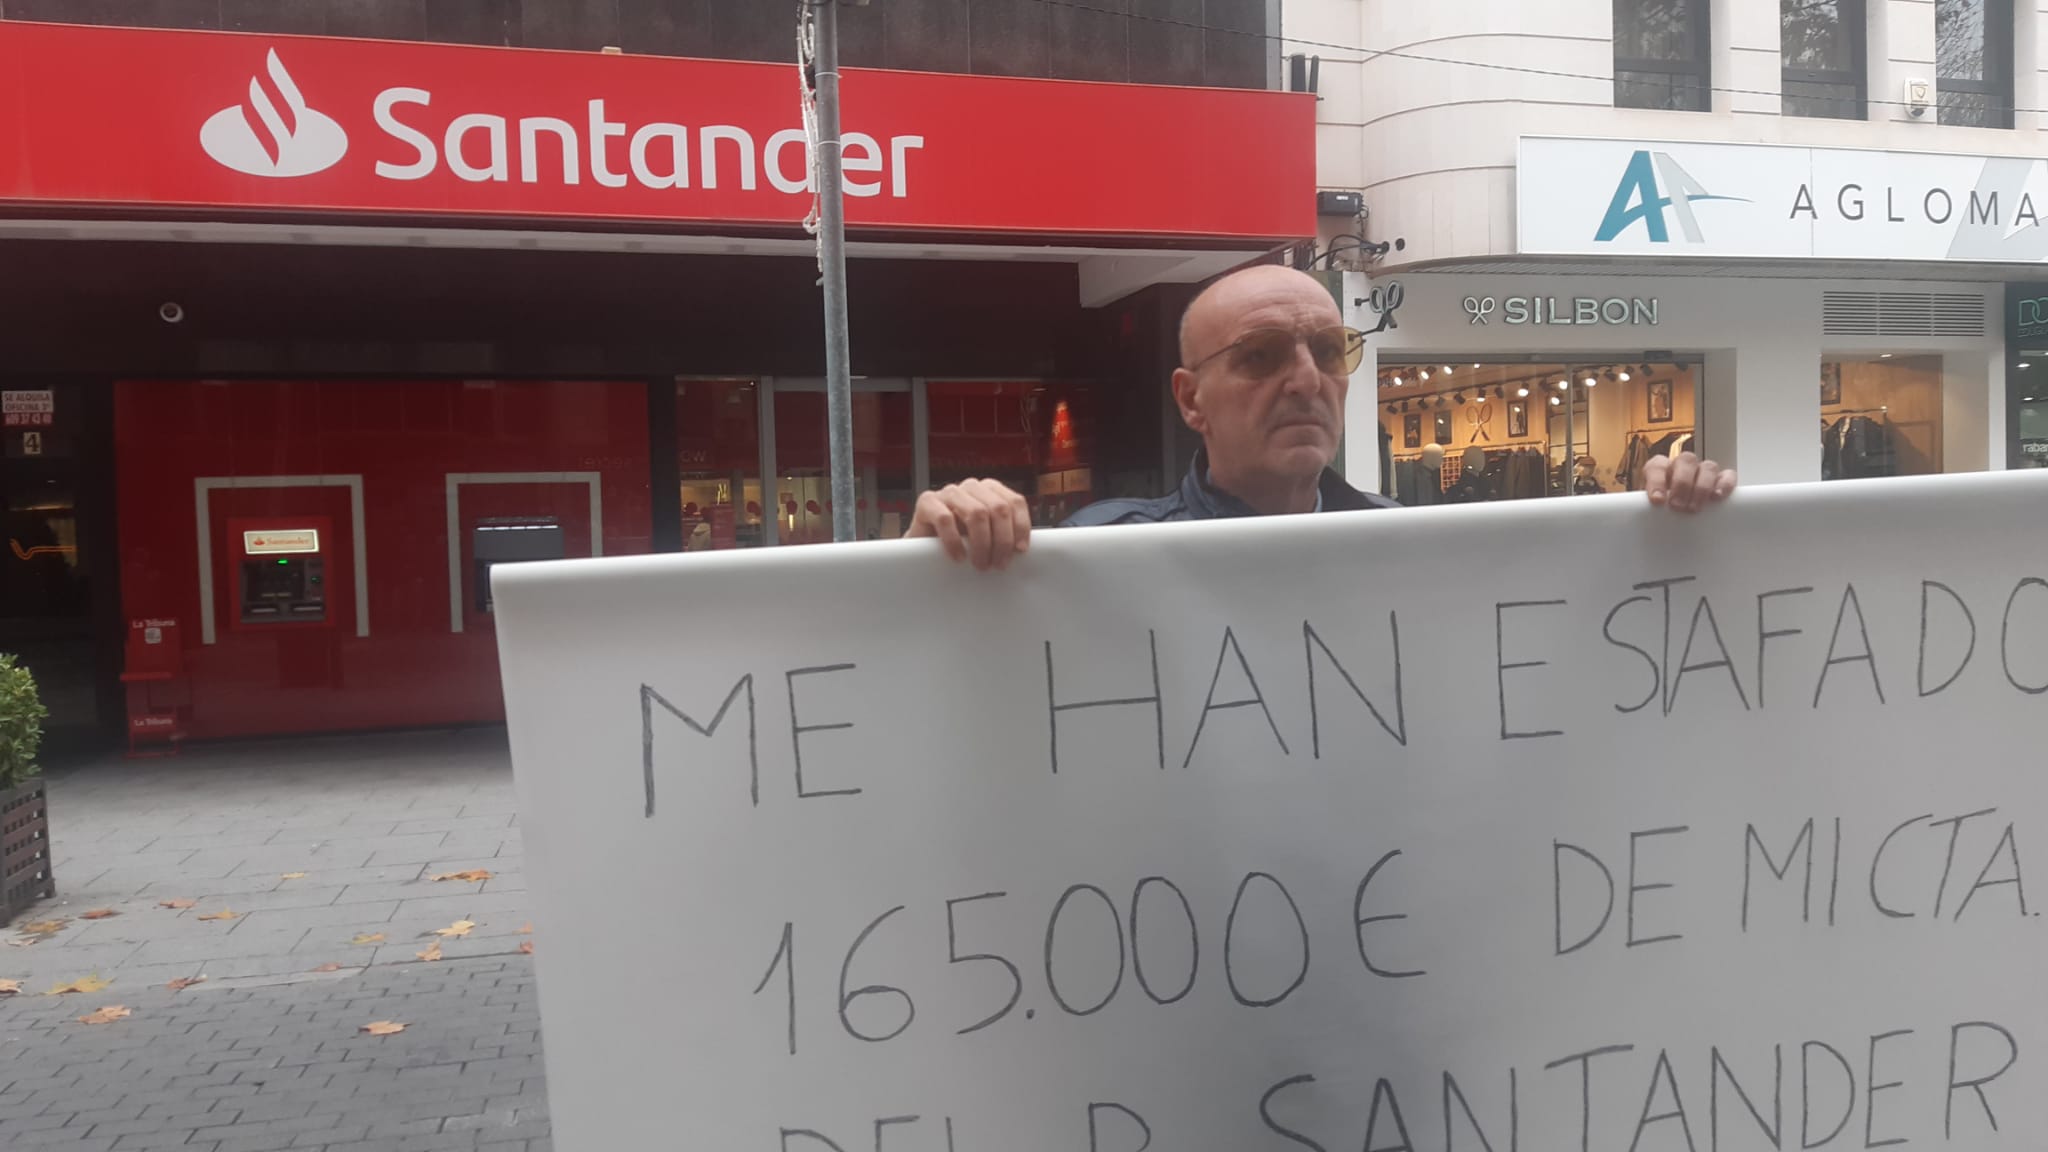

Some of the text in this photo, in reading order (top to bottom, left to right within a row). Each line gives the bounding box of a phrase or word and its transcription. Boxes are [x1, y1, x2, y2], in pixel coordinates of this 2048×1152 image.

[372, 87, 925, 198] Santander
[1789, 183, 2040, 228] AGLOMA
[1503, 296, 1659, 325] SILBON
[25, 433, 39, 452] 4
[641, 576, 2048, 817] ME HAN ESTAFADO
[1554, 825, 1690, 956] DE
